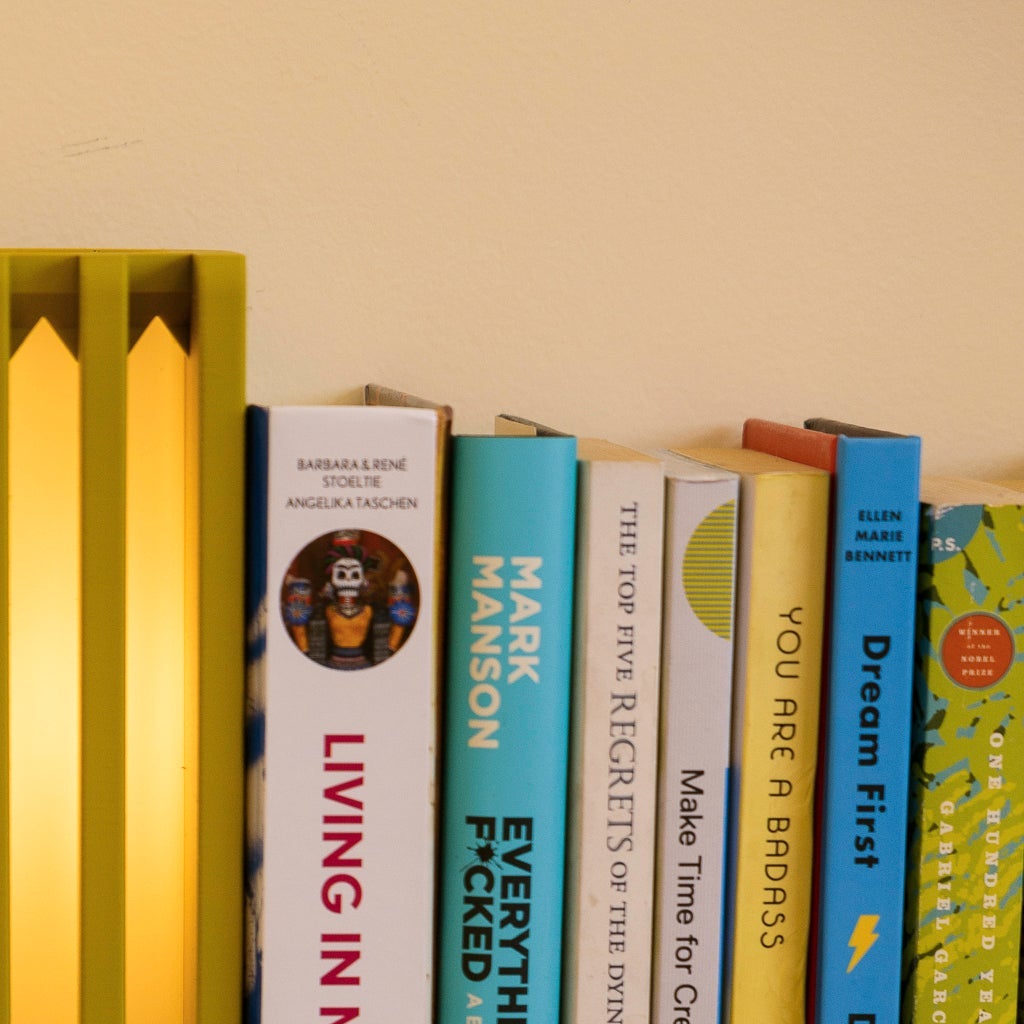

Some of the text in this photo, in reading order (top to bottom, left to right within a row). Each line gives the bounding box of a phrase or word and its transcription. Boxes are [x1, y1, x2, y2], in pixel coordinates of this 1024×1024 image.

[296, 457, 407, 471] BARBARA & RENÉ
[322, 475, 381, 488] STOELTIE
[286, 497, 418, 509] ANGELIKA TASCHEN
[620, 502, 637, 556] THE
[858, 510, 901, 522] ELLEN
[845, 550, 911, 562] BENNETT
[855, 530, 902, 542] MARIE
[618, 565, 635, 614] TOP
[508, 557, 542, 683] MARK
[468, 556, 504, 749] MANSON
[616, 626, 633, 681] FIVE
[607, 693, 636, 853] REGRETS
[760, 607, 803, 948] YOU ARE A BADASS
[855, 636, 891, 868] Dream First
[988, 732, 1005, 789] ONE
[321, 735, 364, 914] LIVING
[679, 770, 704, 846] Make
[611, 861, 627, 892] OF
[676, 855, 702, 925] Time
[935, 801, 955, 931] GABRIEL
[981, 809, 1000, 950] HUNDRED
[609, 901, 626, 954] THE
[674, 934, 698, 975] for
[320, 934, 361, 985] IN
[467, 994, 482, 1008] A
